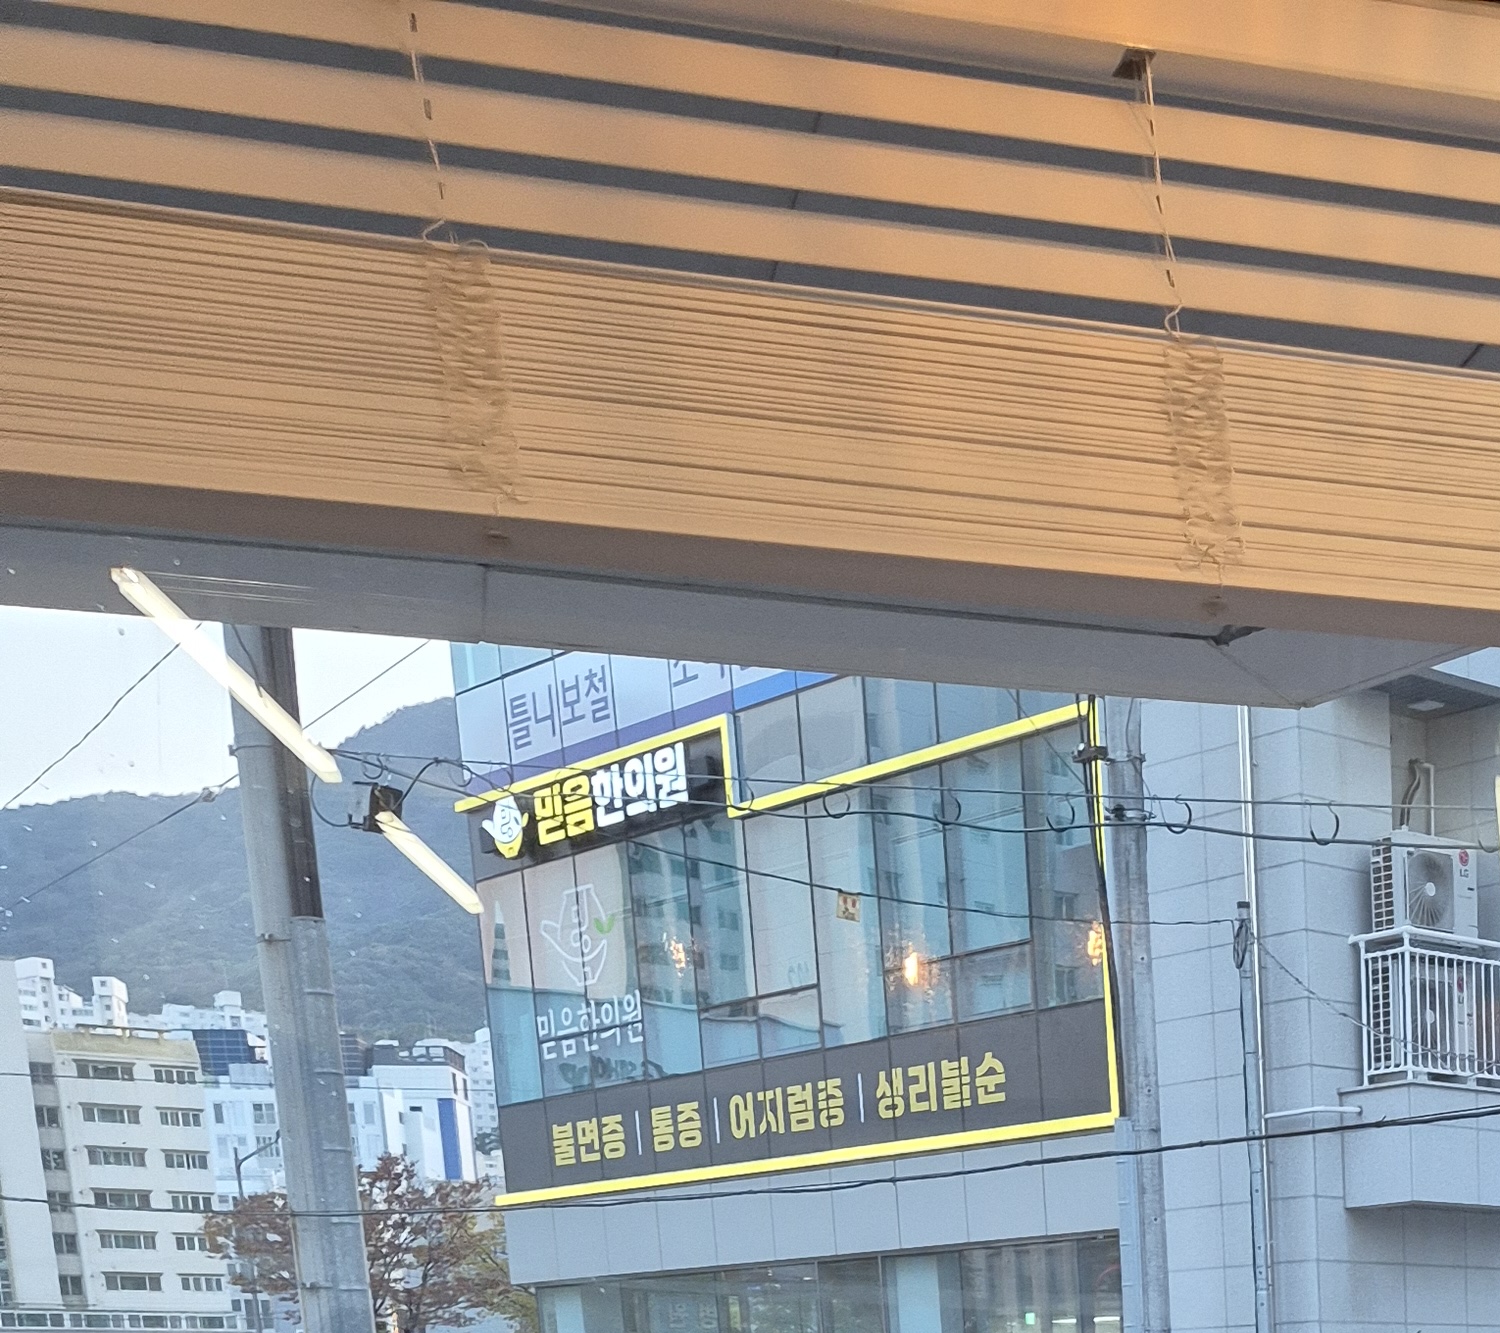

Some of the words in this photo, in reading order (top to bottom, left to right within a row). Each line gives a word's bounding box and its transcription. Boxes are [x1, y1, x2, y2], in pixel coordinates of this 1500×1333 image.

[533, 741, 689, 846] 믿음한의원
[1459, 868, 1469, 879] LG
[536, 989, 644, 1060] 믿음한의원
[552, 1114, 626, 1166] 불면증
[651, 1101, 702, 1152] 통증
[729, 1078, 845, 1140] 어지럼증
[876, 1052, 1006, 1119] 생리불순
